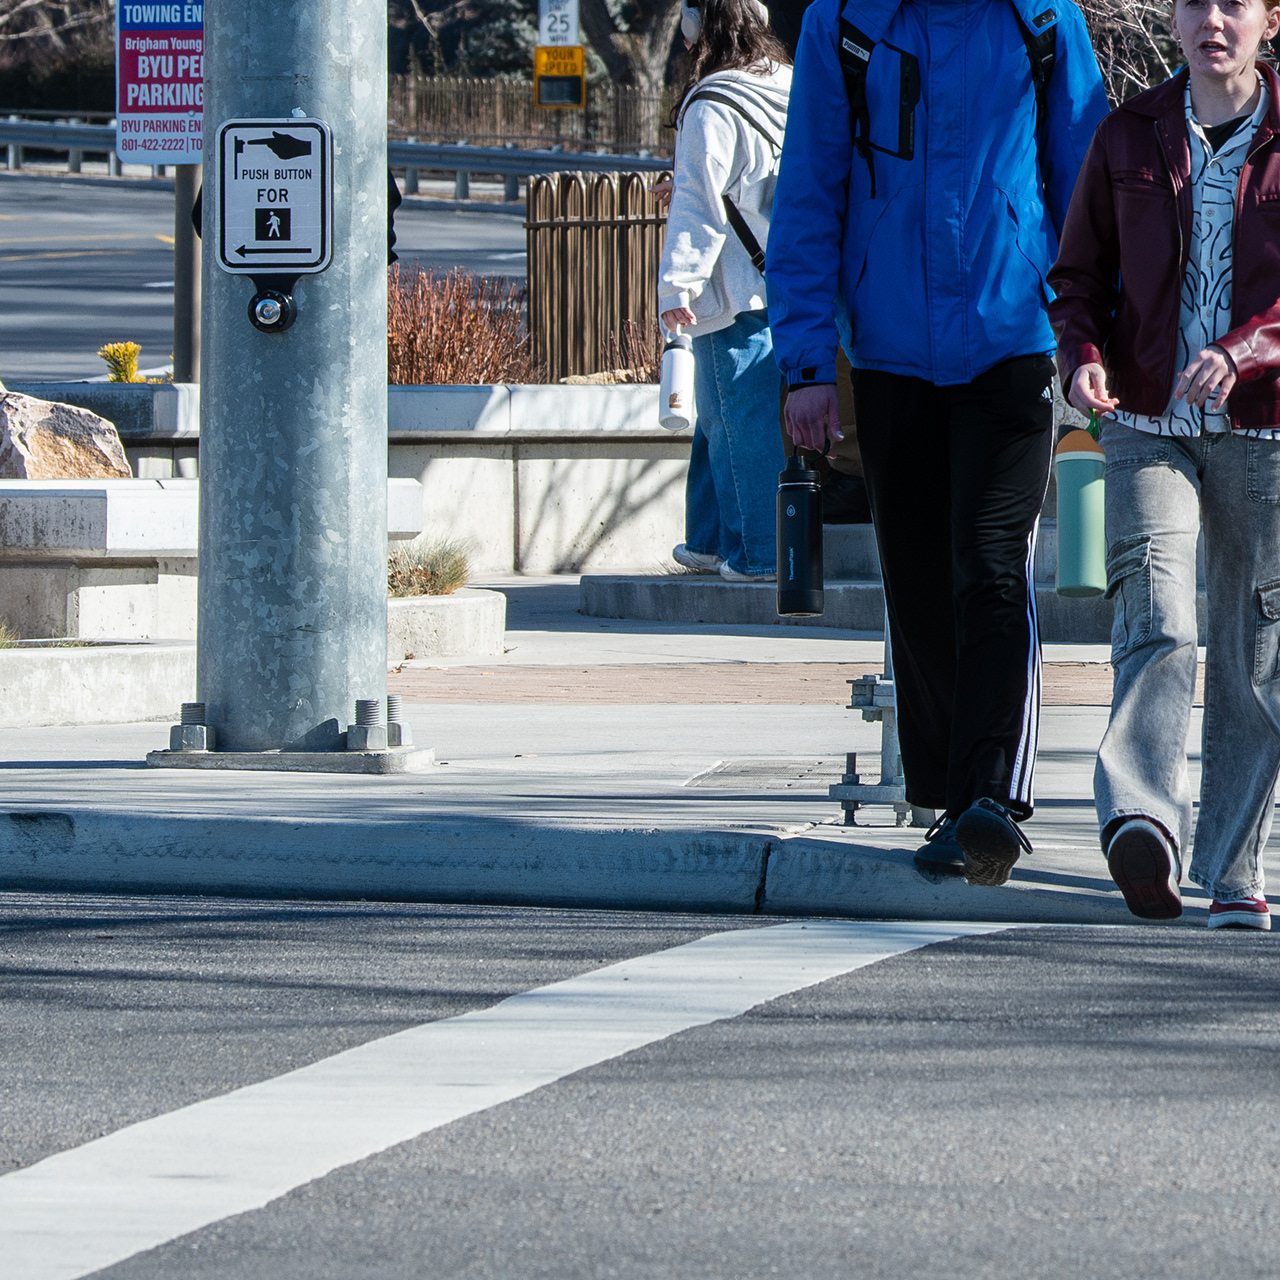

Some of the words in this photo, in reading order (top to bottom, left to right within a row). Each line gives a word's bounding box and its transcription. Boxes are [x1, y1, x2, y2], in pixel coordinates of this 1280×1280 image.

[124, 4, 181, 23] TOWING
[547, 13, 570, 33] 25
[125, 37, 169, 53] Brigham
[170, 37, 202, 53] Young
[546, 49, 574, 60] YOUR
[137, 55, 173, 78] BYU
[544, 62, 577, 74] SPEED
[127, 83, 203, 107] PARKING
[121, 119, 141, 133] BYU
[143, 119, 186, 133] PARKING
[121, 138, 185, 151] 801-422-2222
[242, 169, 269, 180] PUSH
[274, 169, 312, 180] BUTTON
[257, 188, 288, 202] FOR
